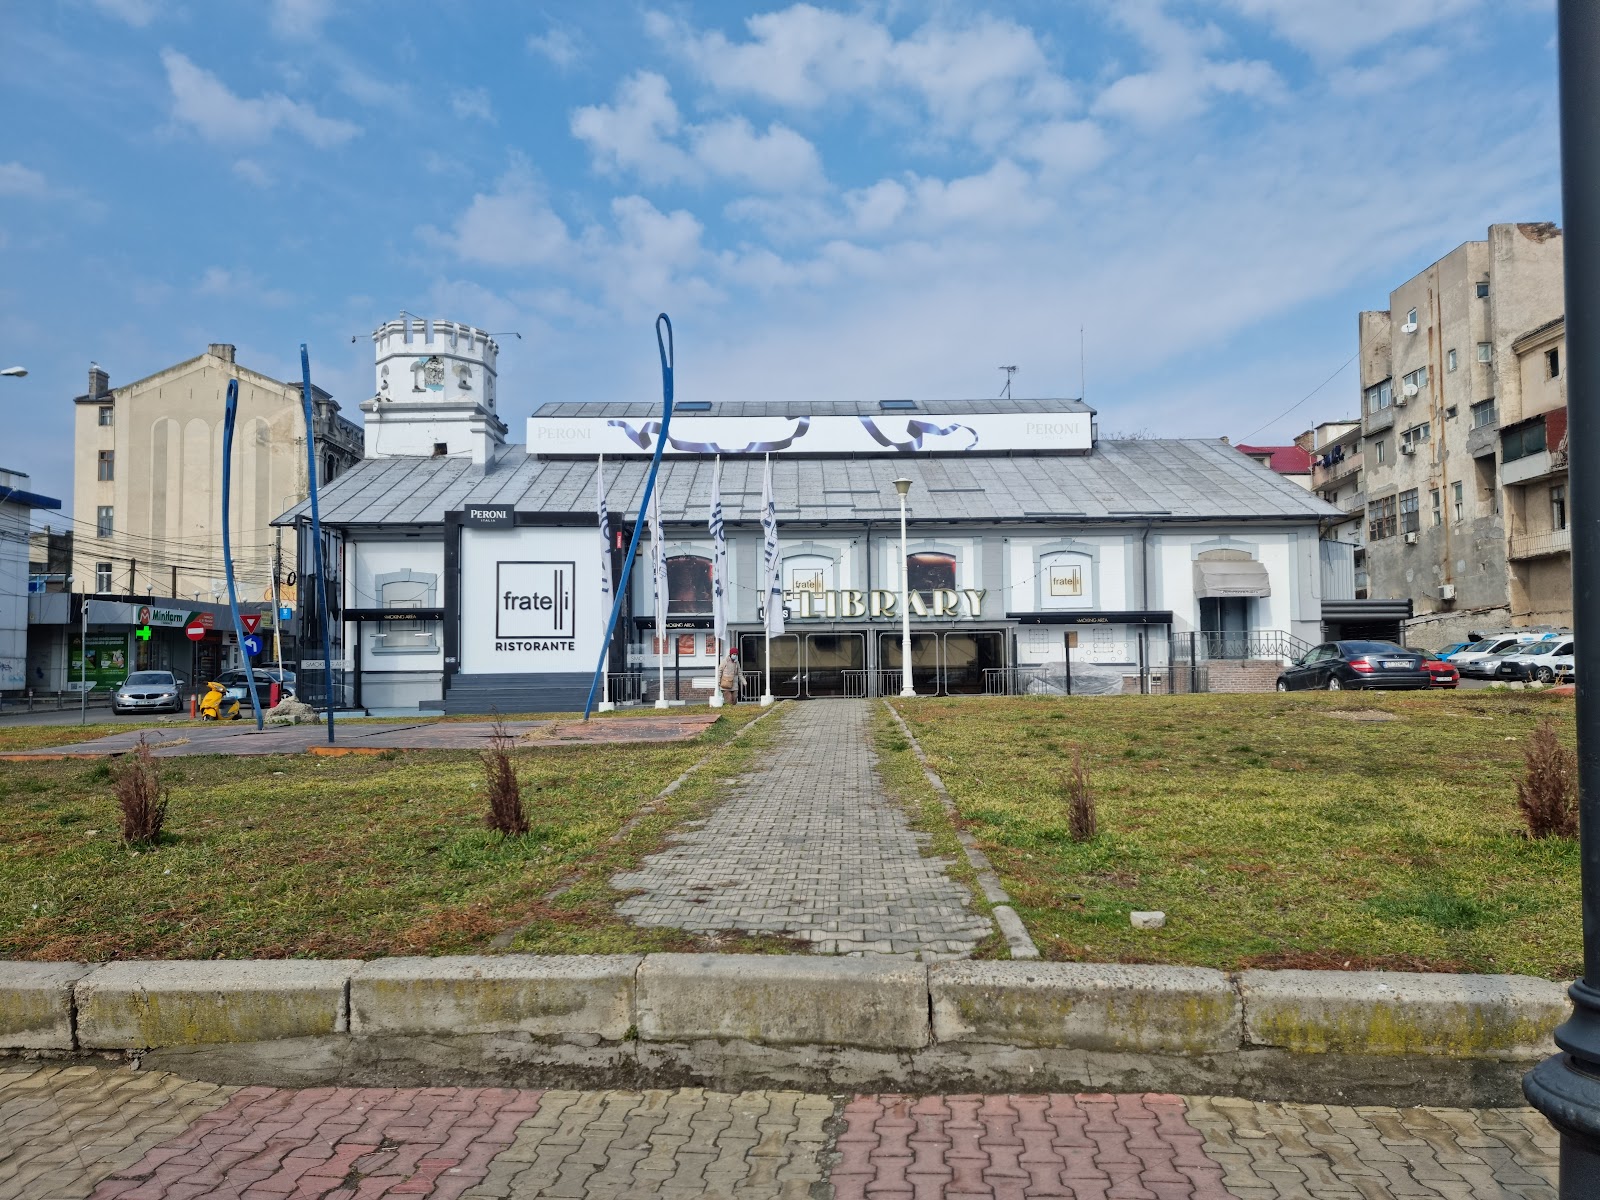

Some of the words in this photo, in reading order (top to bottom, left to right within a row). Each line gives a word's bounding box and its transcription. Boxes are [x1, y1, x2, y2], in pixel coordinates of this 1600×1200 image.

[538, 426, 591, 439] PERONI
[1026, 422, 1080, 435] PERONI
[470, 509, 507, 519] PERONI
[1053, 568, 1080, 593] fratelli
[503, 569, 569, 630] fratelli
[800, 588, 987, 618] LIBRARY
[495, 641, 575, 651] RISTORANTE
